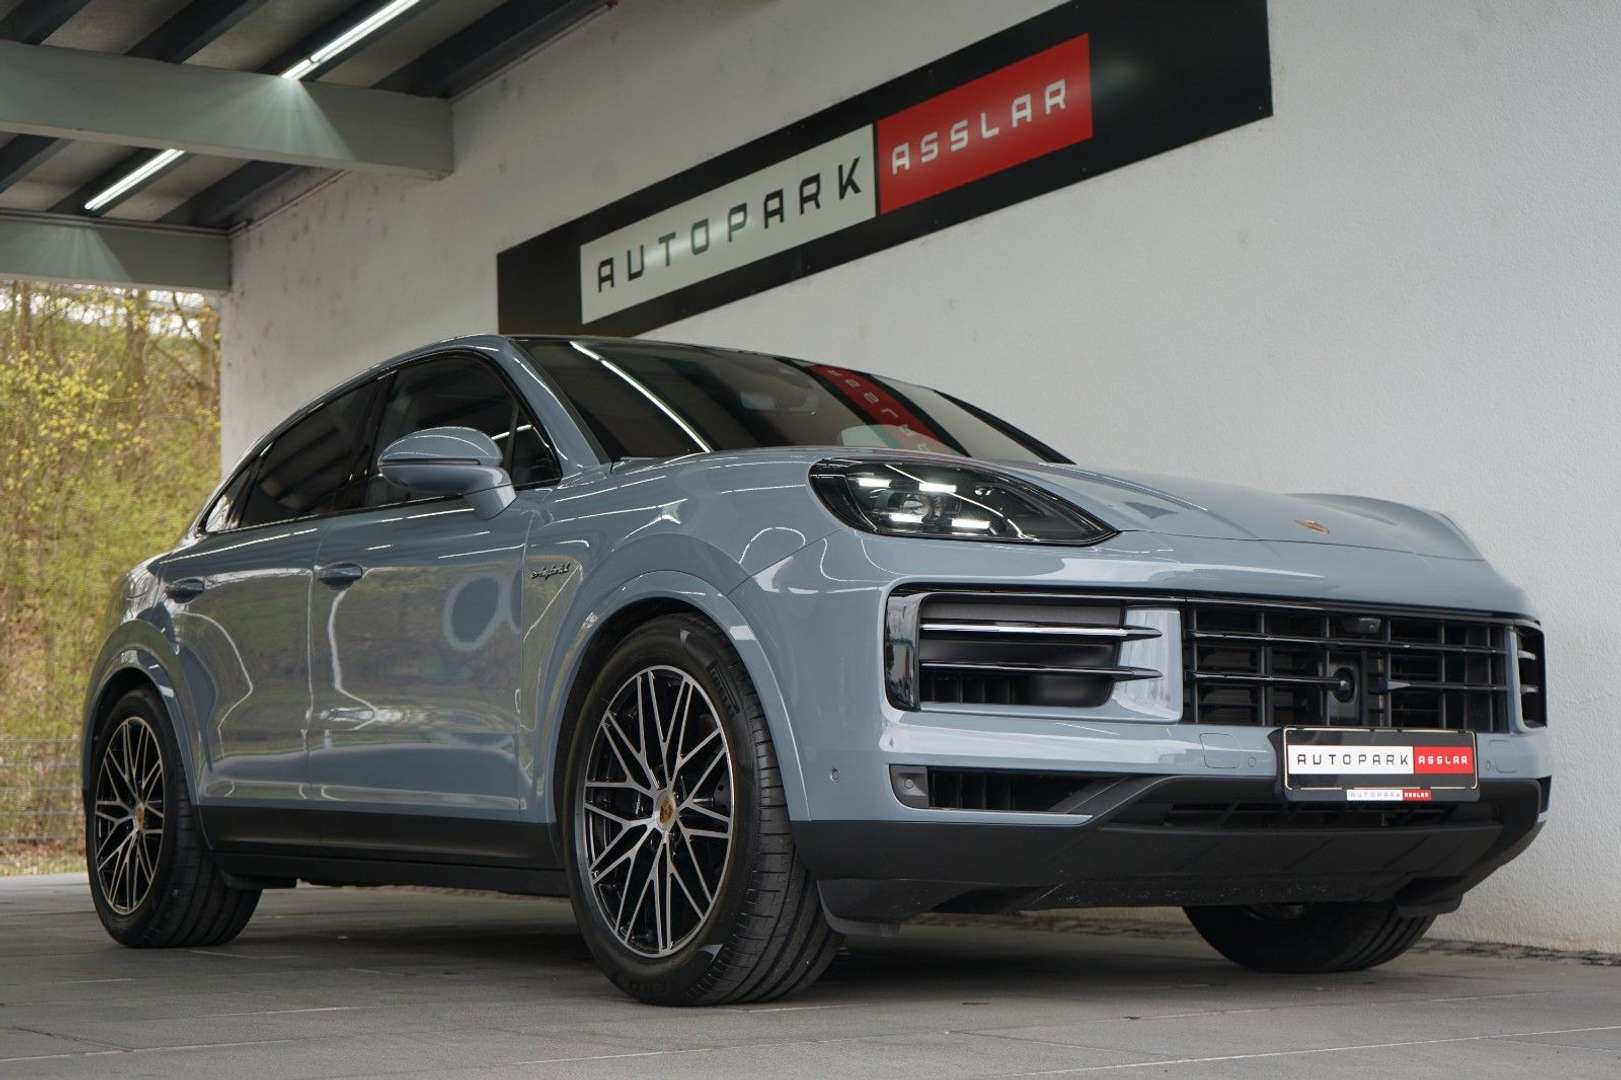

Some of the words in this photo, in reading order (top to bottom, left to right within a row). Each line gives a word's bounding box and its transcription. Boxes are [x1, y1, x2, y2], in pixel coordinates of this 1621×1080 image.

[597, 156, 862, 293] AUTOPARK
[891, 79, 1067, 175] ASSLAR
[1297, 753, 1409, 766] AUTOPARK
[1418, 755, 1468, 765] ASSLAR
